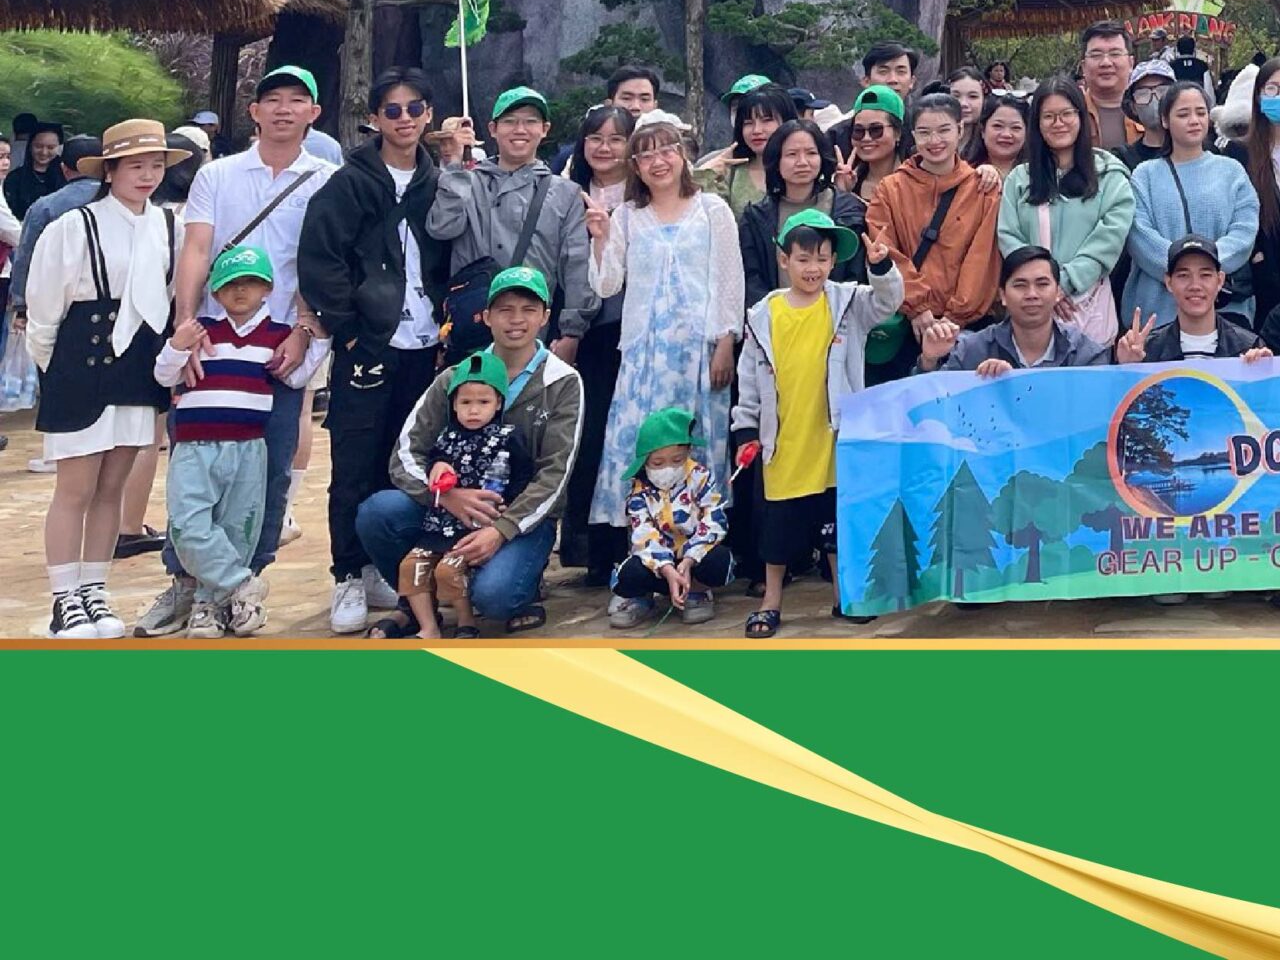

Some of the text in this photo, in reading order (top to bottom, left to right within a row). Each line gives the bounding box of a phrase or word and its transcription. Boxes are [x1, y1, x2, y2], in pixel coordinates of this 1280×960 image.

[1121, 516, 1175, 540] WE
[1188, 512, 1261, 539] ARE
[1098, 550, 1183, 576] GEAR
[1196, 548, 1237, 572] UP
